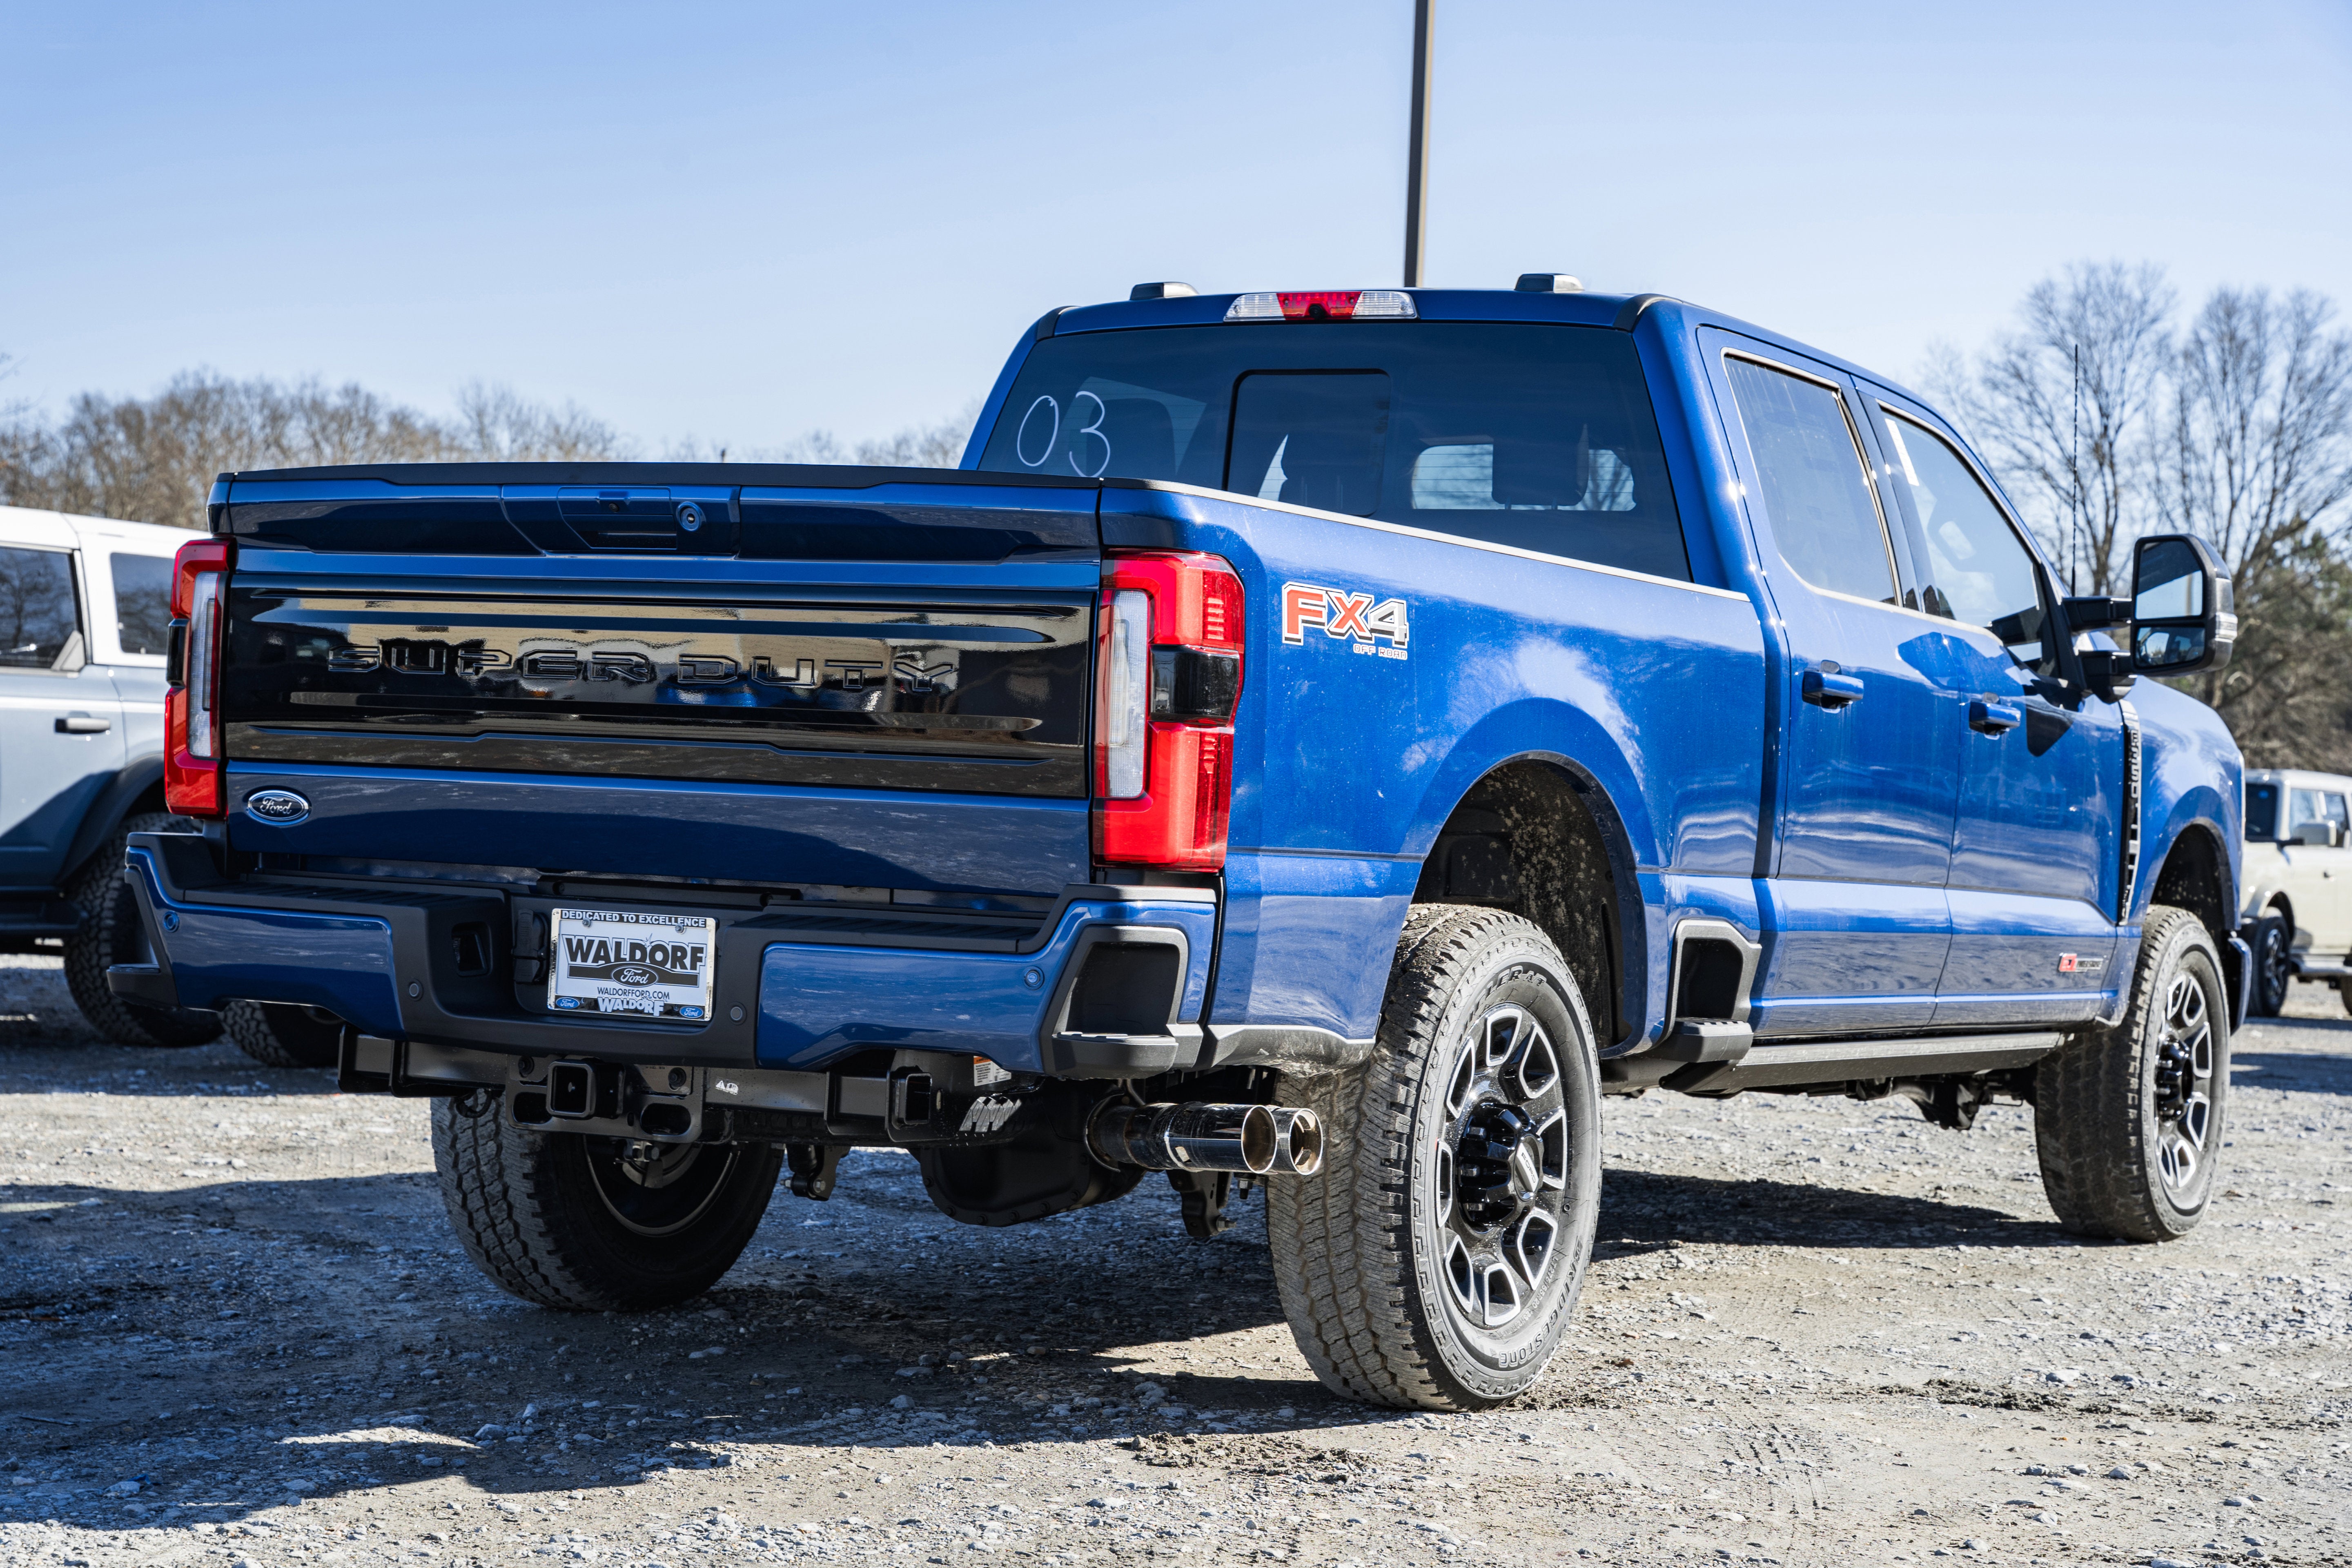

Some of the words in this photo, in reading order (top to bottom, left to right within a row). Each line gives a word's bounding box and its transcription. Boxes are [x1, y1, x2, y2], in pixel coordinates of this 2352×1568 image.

[1017, 391, 1110, 477] 03
[1282, 581, 1409, 648] FX4
[1354, 644, 1376, 655] OFF
[1379, 647, 1407, 660] ROAD
[328, 645, 650, 682] SUPER
[677, 653, 953, 691] DUTY
[260, 796, 292, 814] Ford
[561, 910, 619, 922] DEDICATED
[622, 914, 636, 923] TO
[639, 915, 705, 927] EXCELLENCE
[564, 937, 705, 971] WALDORF
[620, 968, 649, 984] Ford
[560, 998, 575, 1007] Ford
[597, 987, 670, 1000] WALDORFFORD.COM
[597, 996, 664, 1017] WALDORF
[684, 1007, 698, 1016] Ford
[1521, 1152, 1536, 1183] FORD
[1499, 1235, 1583, 1368] BRIDGESTONE
